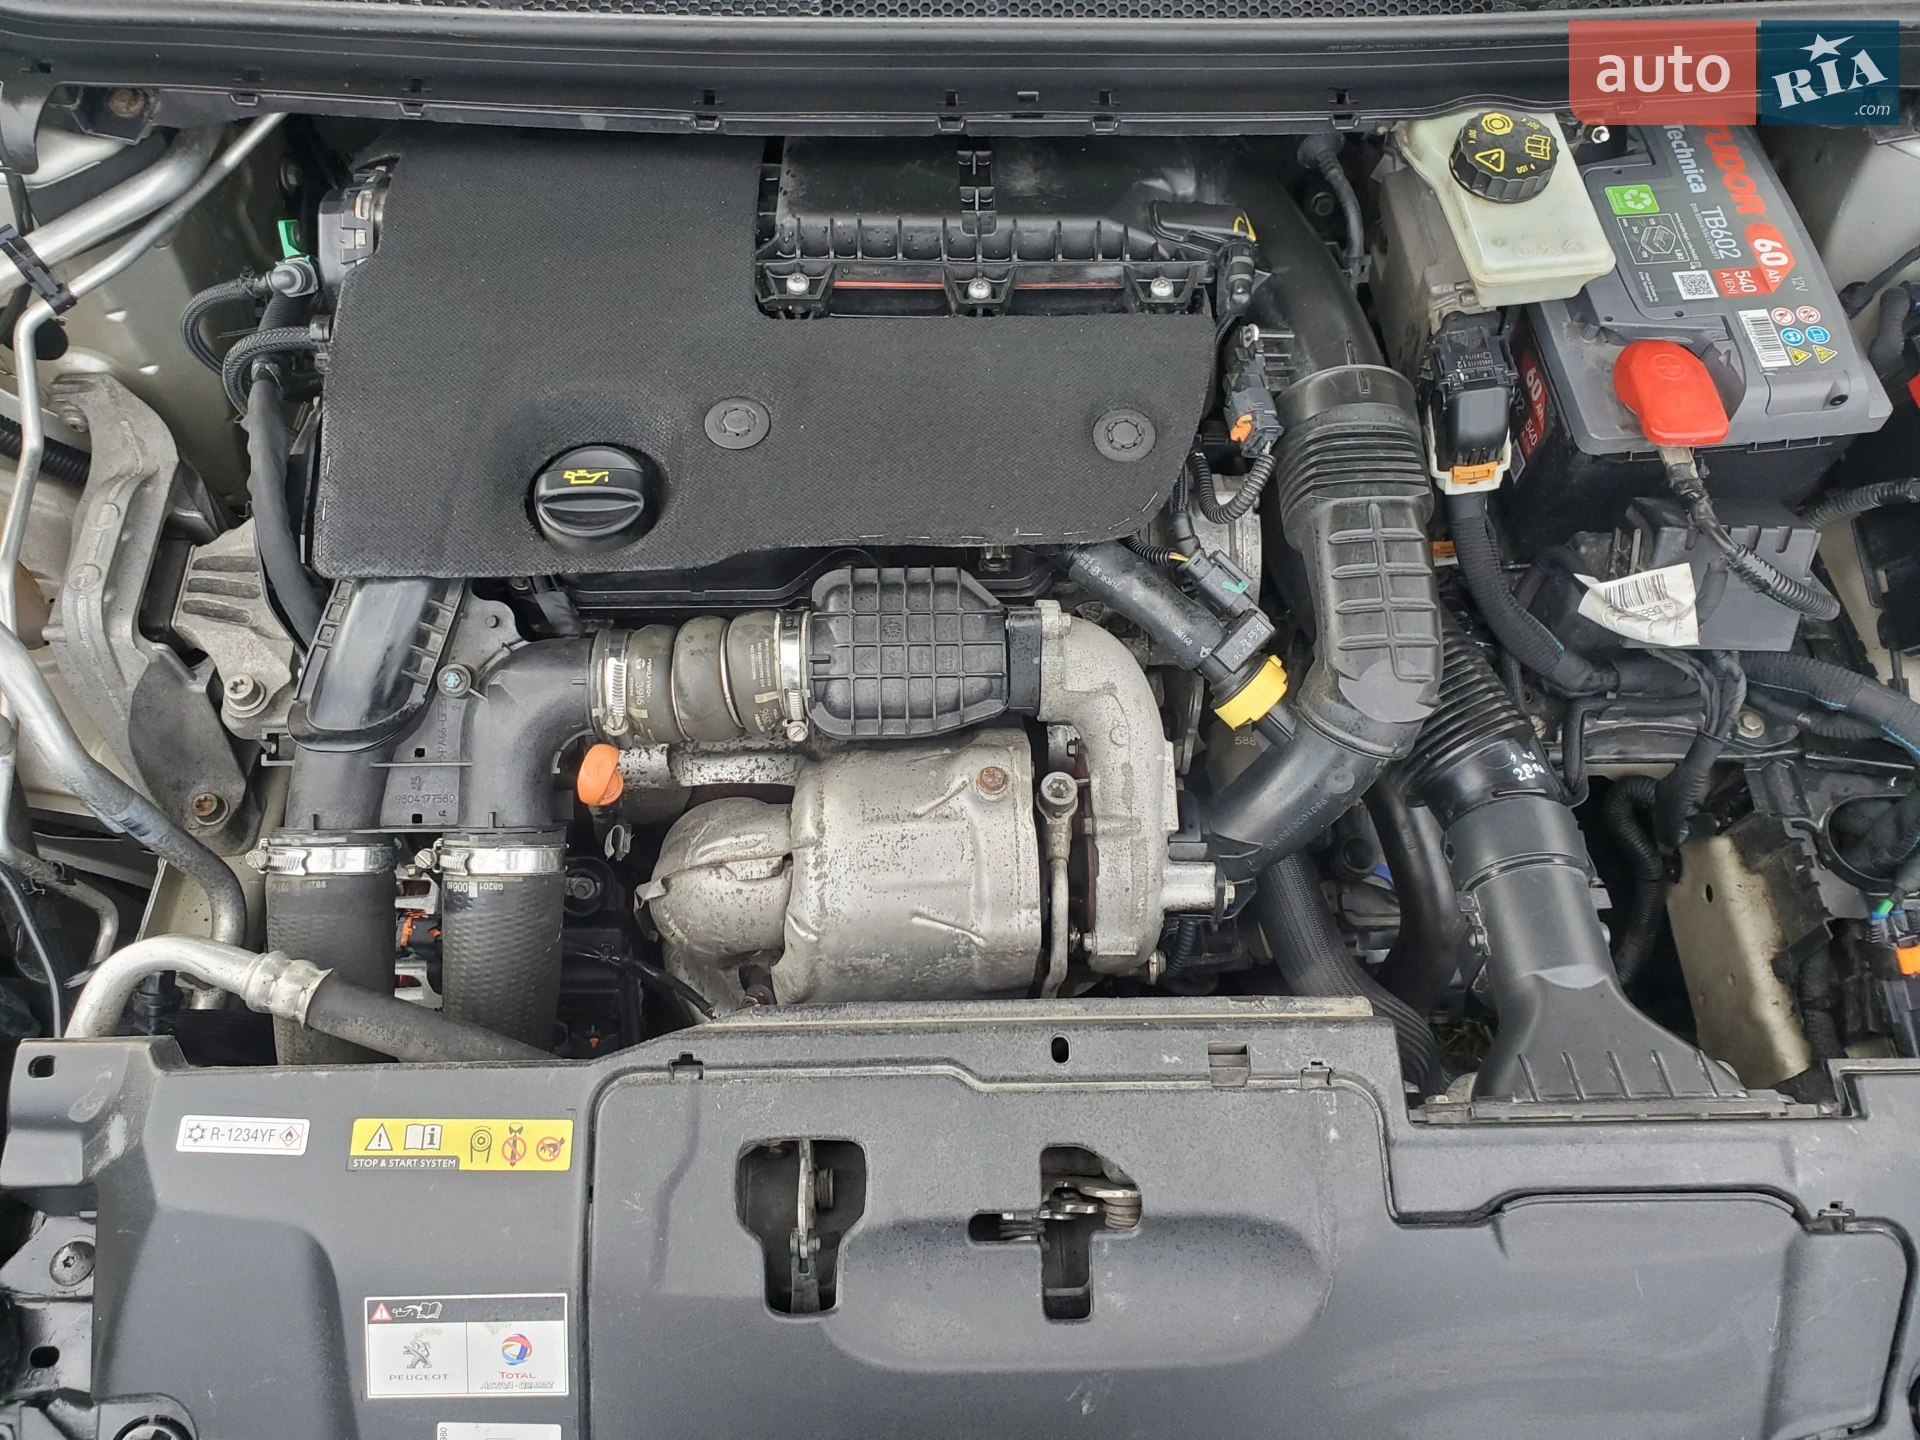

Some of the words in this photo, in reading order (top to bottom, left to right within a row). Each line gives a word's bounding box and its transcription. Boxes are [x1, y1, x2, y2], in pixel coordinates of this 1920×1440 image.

[1663, 121, 1707, 194] Technica
[1699, 117, 1766, 215] TUDOR
[1701, 205, 1741, 259] TB602
[1753, 238, 1789, 266] 60
[1735, 270, 1757, 293] 540
[1766, 269, 1782, 283] Ah
[1791, 276, 1809, 292] 12V
[1526, 367, 1543, 401] 60
[1526, 418, 1538, 446] 540
[479, 882, 504, 891] 98201
[209, 1127, 277, 1143] R-1234YF
[353, 1158, 378, 1168] STOP
[379, 1158, 387, 1168] &
[389, 1158, 418, 1168] START
[419, 1158, 456, 1168] SYSTEM
[389, 1373, 449, 1381] PEUGEOT
[499, 1371, 536, 1379] TOTAL
